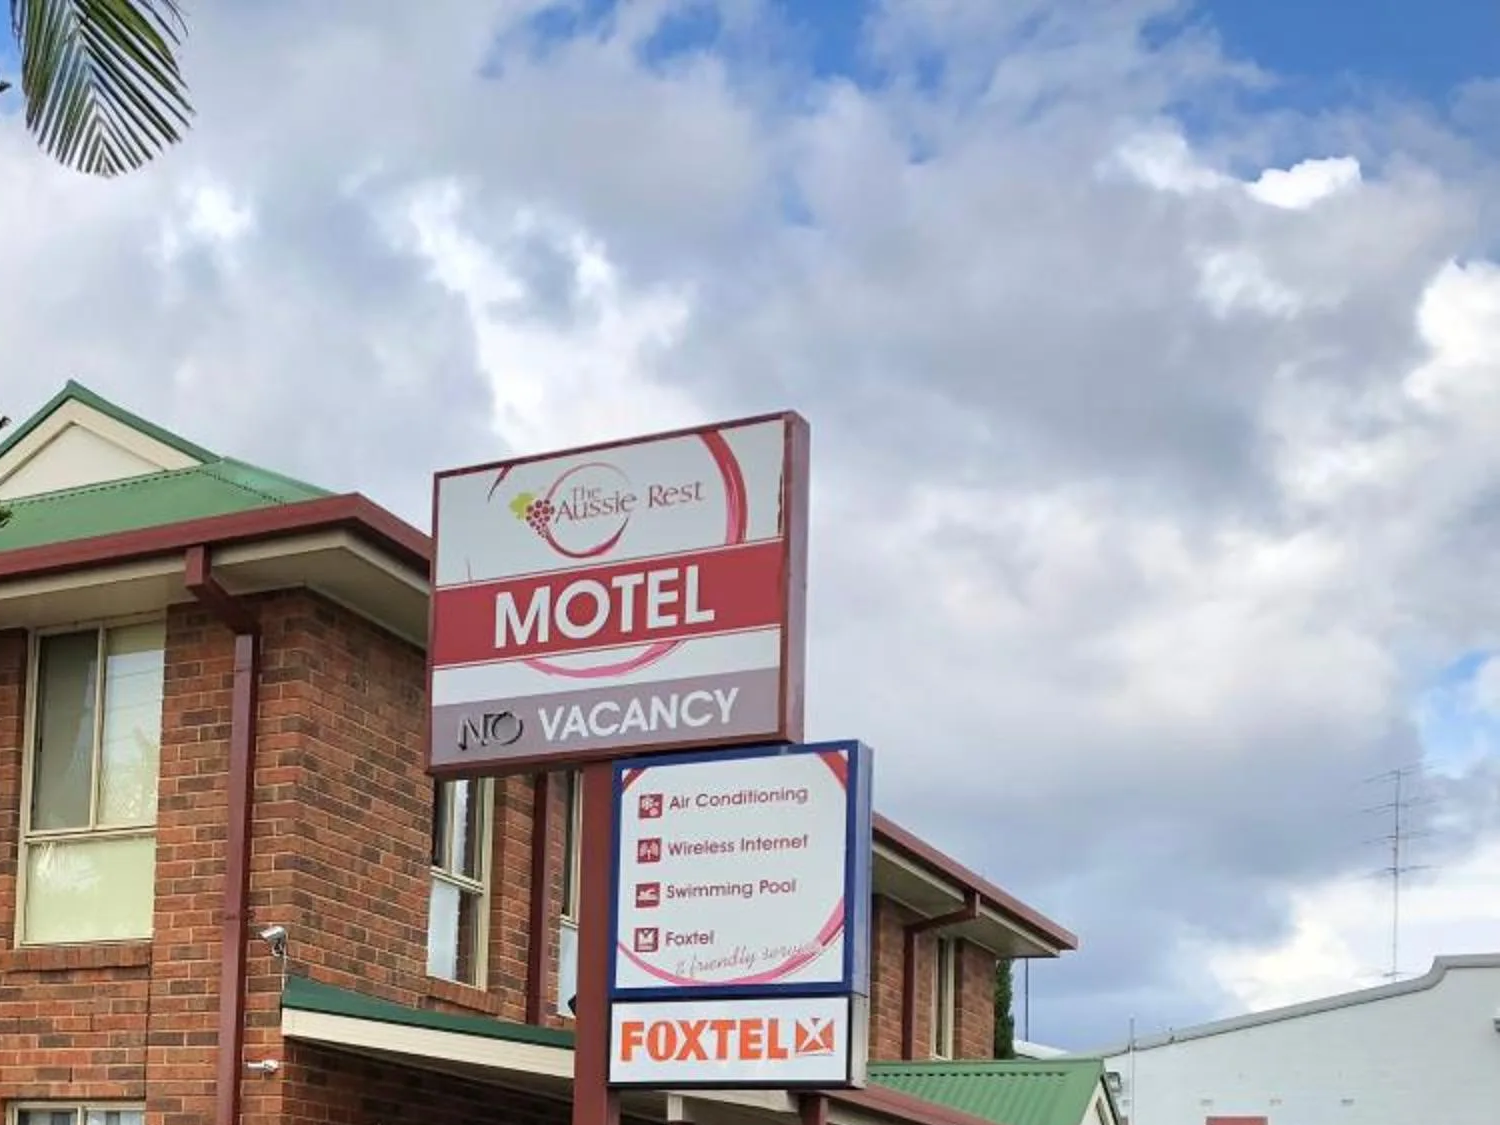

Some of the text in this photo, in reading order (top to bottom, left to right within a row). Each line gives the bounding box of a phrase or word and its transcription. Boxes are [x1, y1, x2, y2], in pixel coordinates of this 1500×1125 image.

[555, 481, 705, 524] Aussie Rest
[572, 485, 601, 500] The
[494, 565, 715, 649] MOTEL
[457, 687, 740, 750] NO VACANCY
[669, 786, 809, 809] Air Conditioning
[667, 834, 809, 856] Wireless Internet
[666, 878, 797, 899] Swimming Pool
[665, 930, 715, 946] Foxtel
[619, 1018, 789, 1063] FOXTEL
